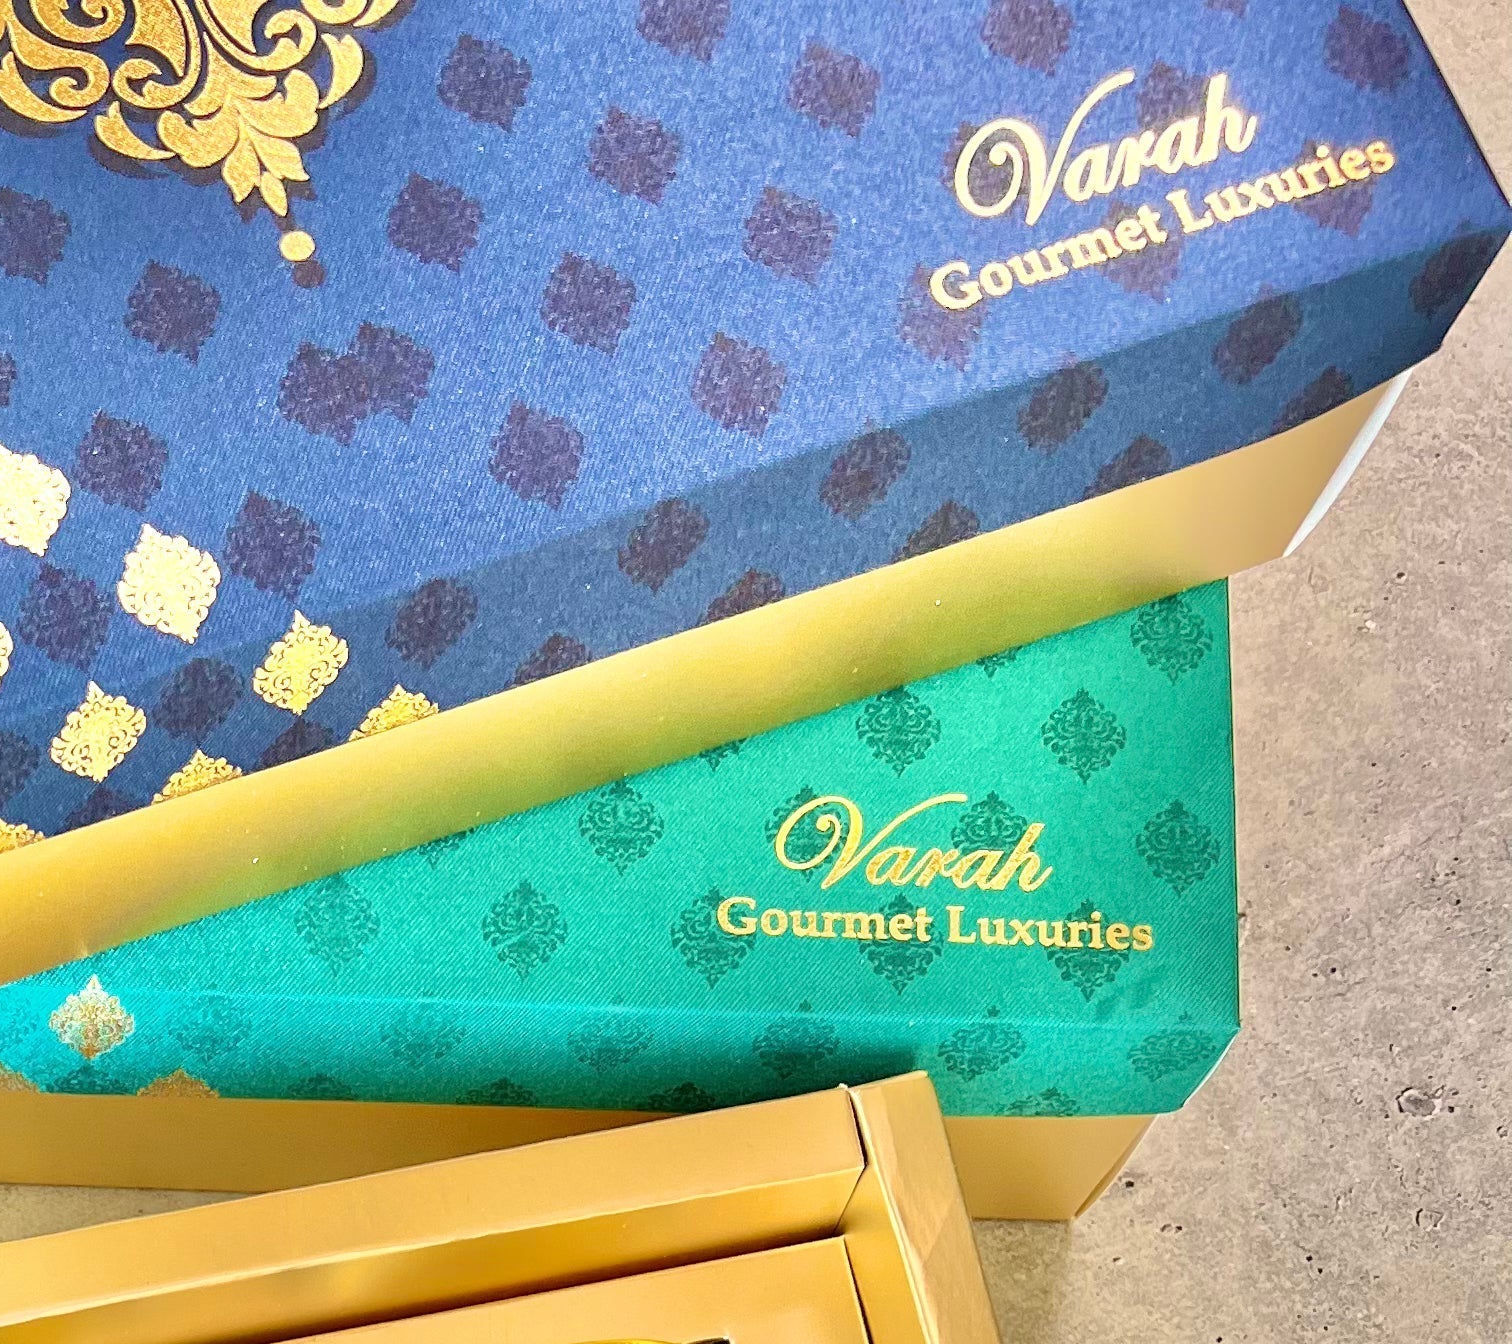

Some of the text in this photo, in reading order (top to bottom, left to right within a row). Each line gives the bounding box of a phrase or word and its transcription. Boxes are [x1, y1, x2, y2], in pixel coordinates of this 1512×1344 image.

[954, 69, 1258, 225] Varah
[929, 139, 1397, 310] Gourmet Luxuries
[774, 793, 1054, 892] Varah
[716, 896, 1154, 950] Gourmet Luxuries
